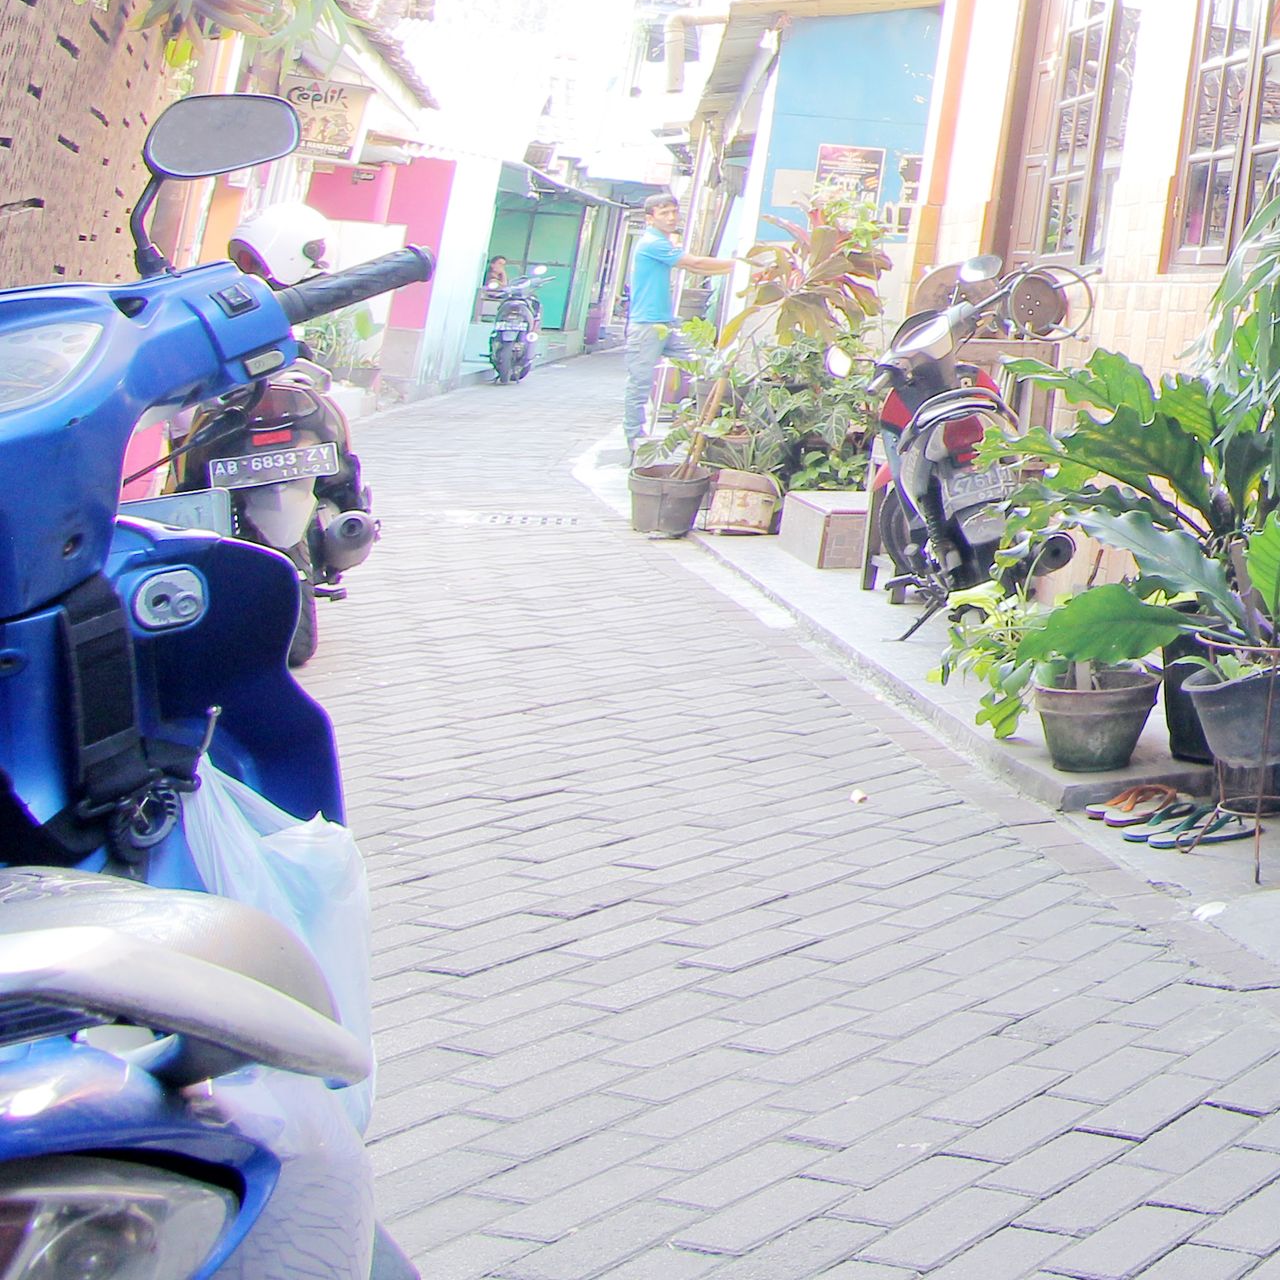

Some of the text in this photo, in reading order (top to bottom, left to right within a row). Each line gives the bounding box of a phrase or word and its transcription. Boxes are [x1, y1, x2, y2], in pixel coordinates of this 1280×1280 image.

[287, 85, 348, 110] Ceplik
[214, 446, 329, 475] AB 6833 ZY
